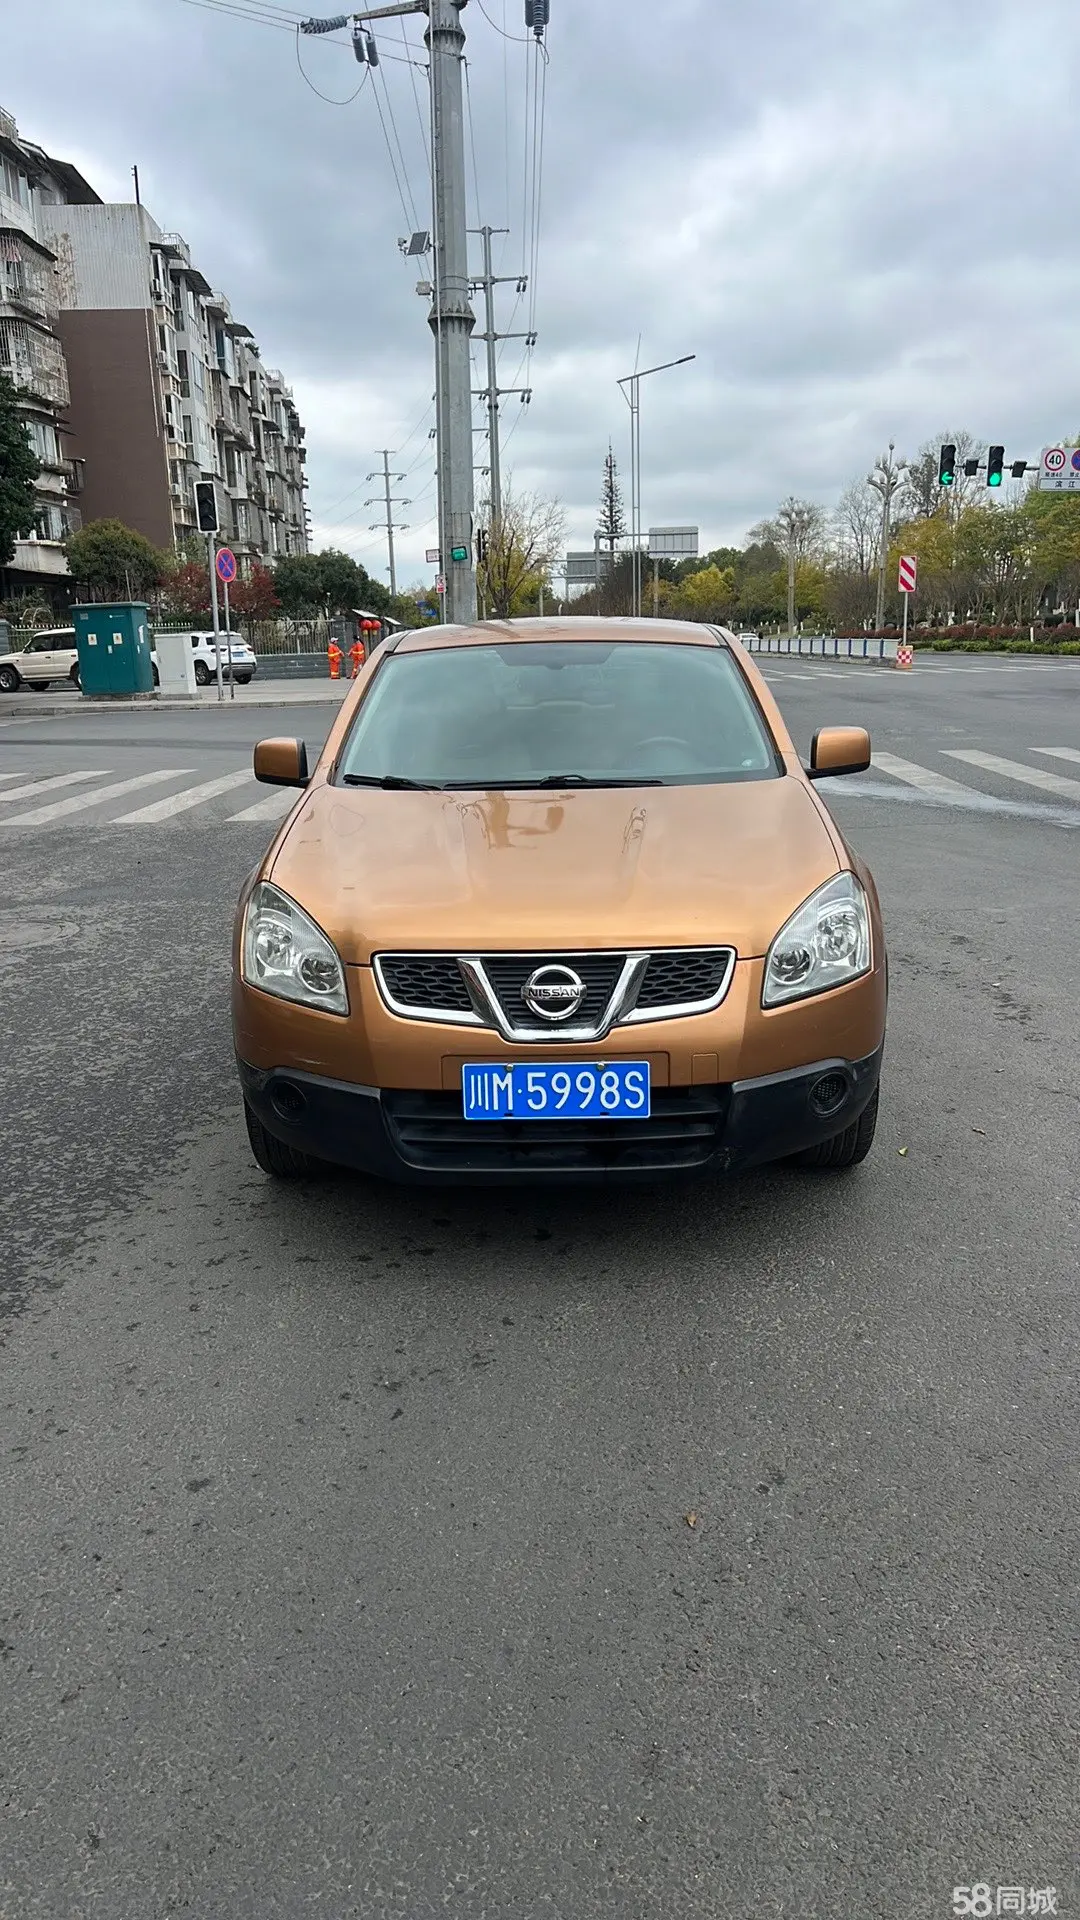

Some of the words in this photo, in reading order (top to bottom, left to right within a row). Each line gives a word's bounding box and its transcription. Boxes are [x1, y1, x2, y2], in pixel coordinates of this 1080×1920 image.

[1049, 455, 1062, 465] 40
[528, 986, 580, 997] NISSAN
[469, 1070, 645, 1111] 川M·5998S
